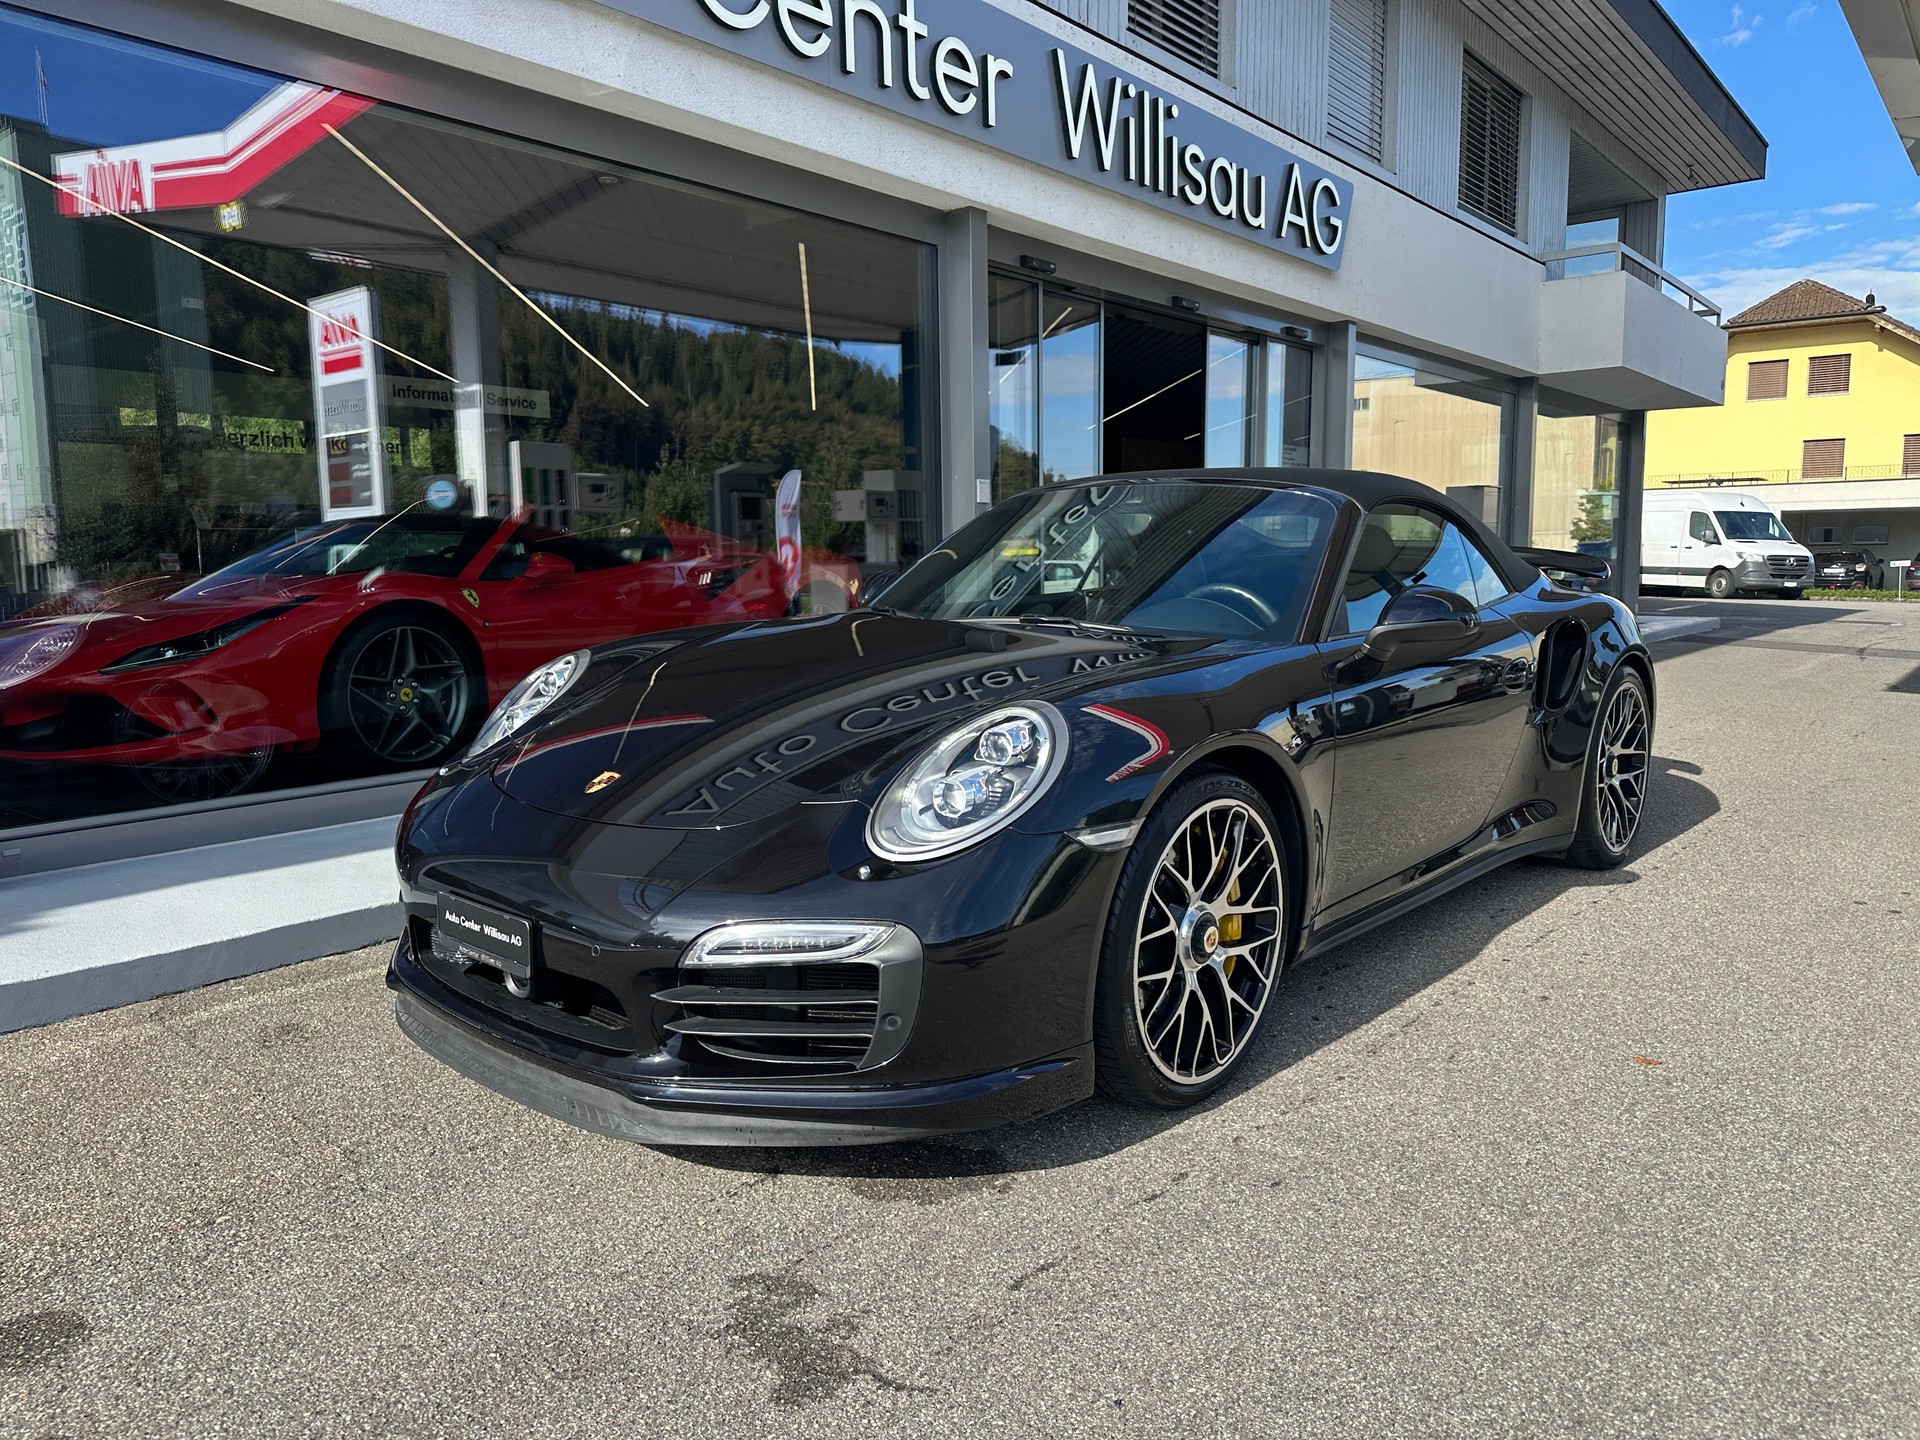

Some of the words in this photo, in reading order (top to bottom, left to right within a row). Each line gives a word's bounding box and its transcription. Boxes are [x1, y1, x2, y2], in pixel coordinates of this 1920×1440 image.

[1053, 48, 1265, 230] Willisau
[1279, 163, 1342, 255] AG
[486, 392, 537, 410] Service
[445, 909, 460, 924] Auto
[460, 915, 481, 933] Center
[483, 923, 510, 943] Willisau
[510, 933, 523, 947] AG
